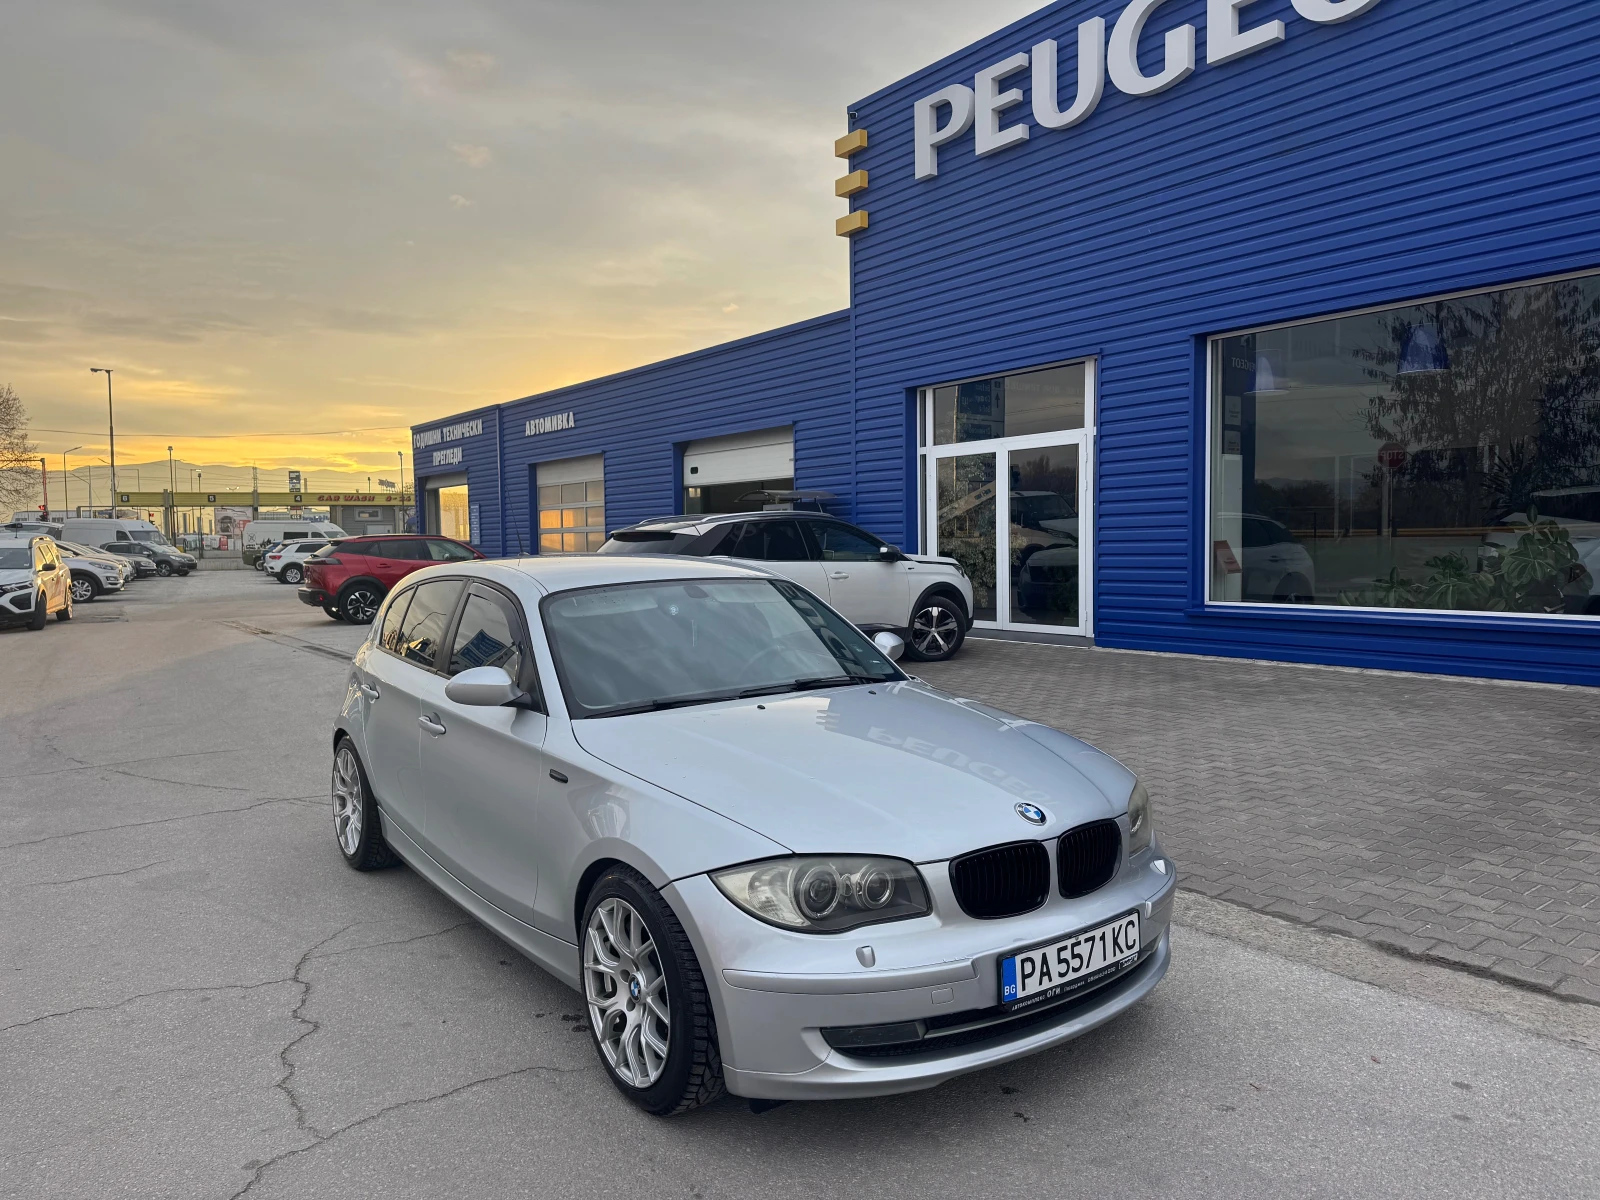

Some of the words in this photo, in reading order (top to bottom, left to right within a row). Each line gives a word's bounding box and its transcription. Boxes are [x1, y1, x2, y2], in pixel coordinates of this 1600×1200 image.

[914, 0, 1388, 180] PEUGE
[413, 428, 442, 450] ГОДИШНИ
[443, 418, 483, 442] ТЕХНИЧЕСКИ
[525, 411, 575, 437] АВТОМИВКА
[432, 447, 463, 466] ПРЕГЛЕДИ
[1004, 984, 1016, 996] BG
[1046, 986, 1061, 998] ОГИ
